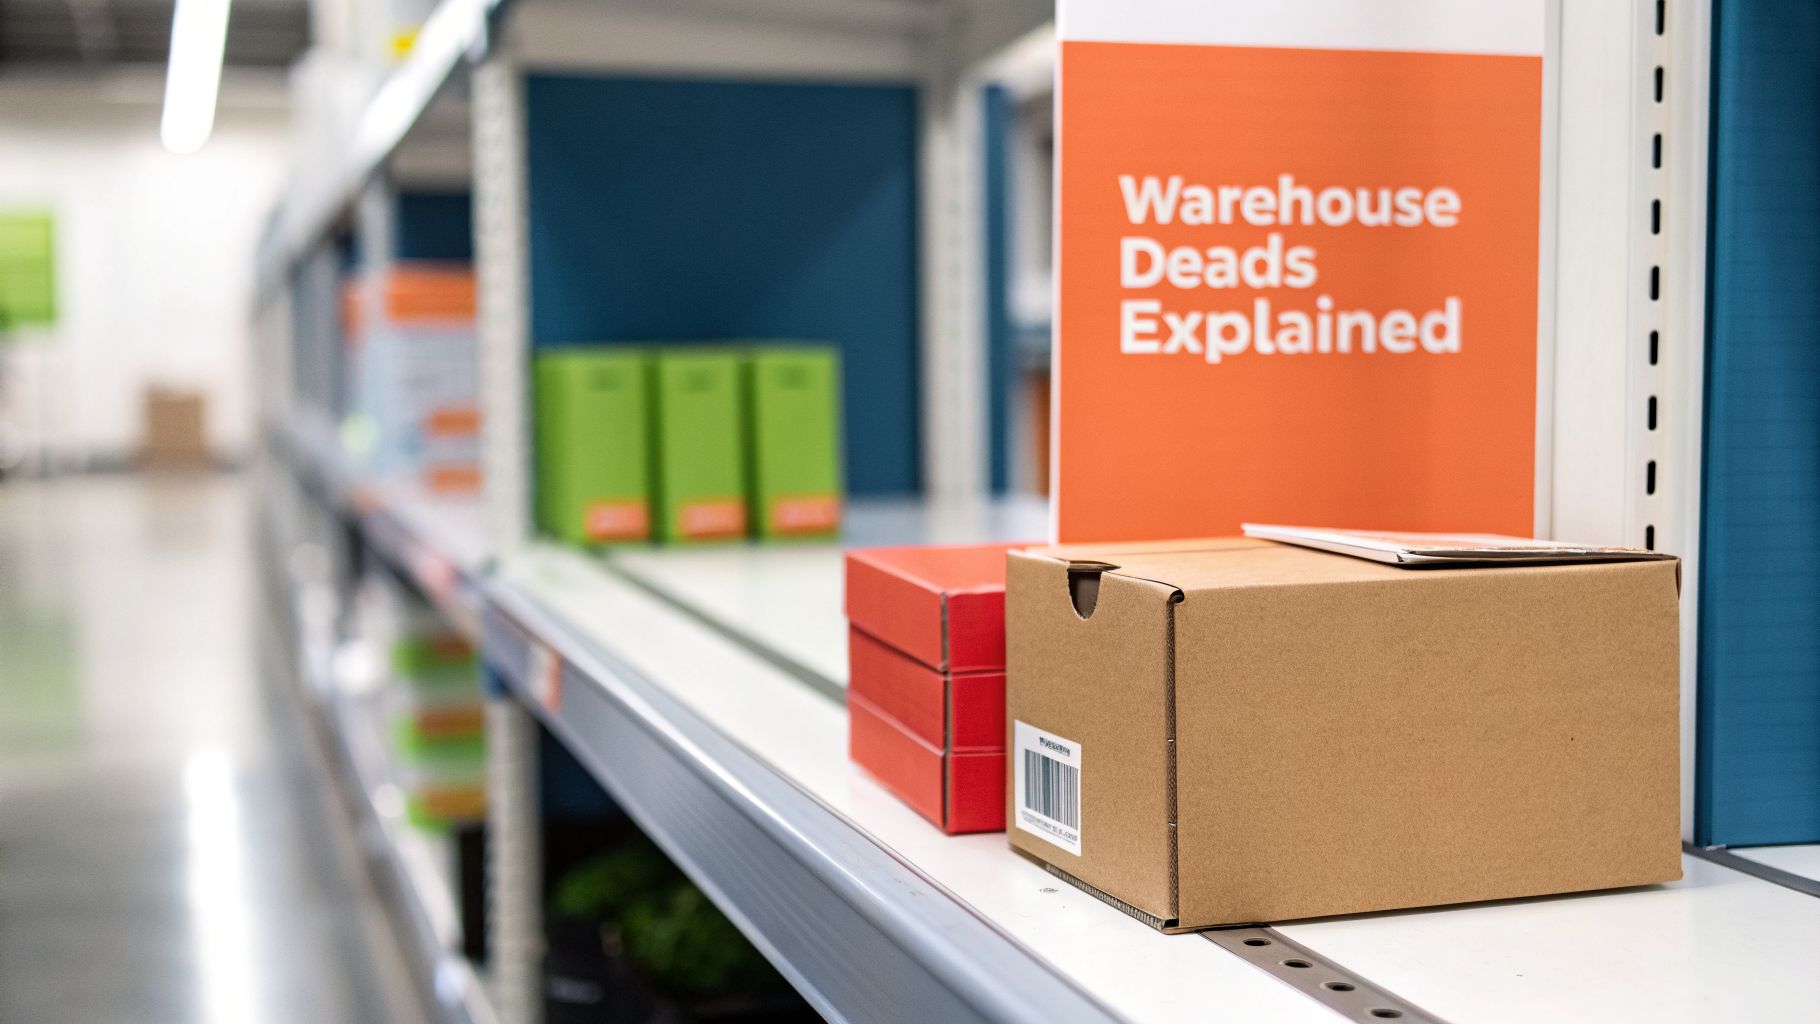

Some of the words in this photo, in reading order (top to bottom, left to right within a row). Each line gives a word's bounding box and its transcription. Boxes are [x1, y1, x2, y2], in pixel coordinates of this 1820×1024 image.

[1119, 174, 1461, 227] Warehouse
[1120, 233, 1317, 288] Deads
[1120, 294, 1461, 364] Explained
